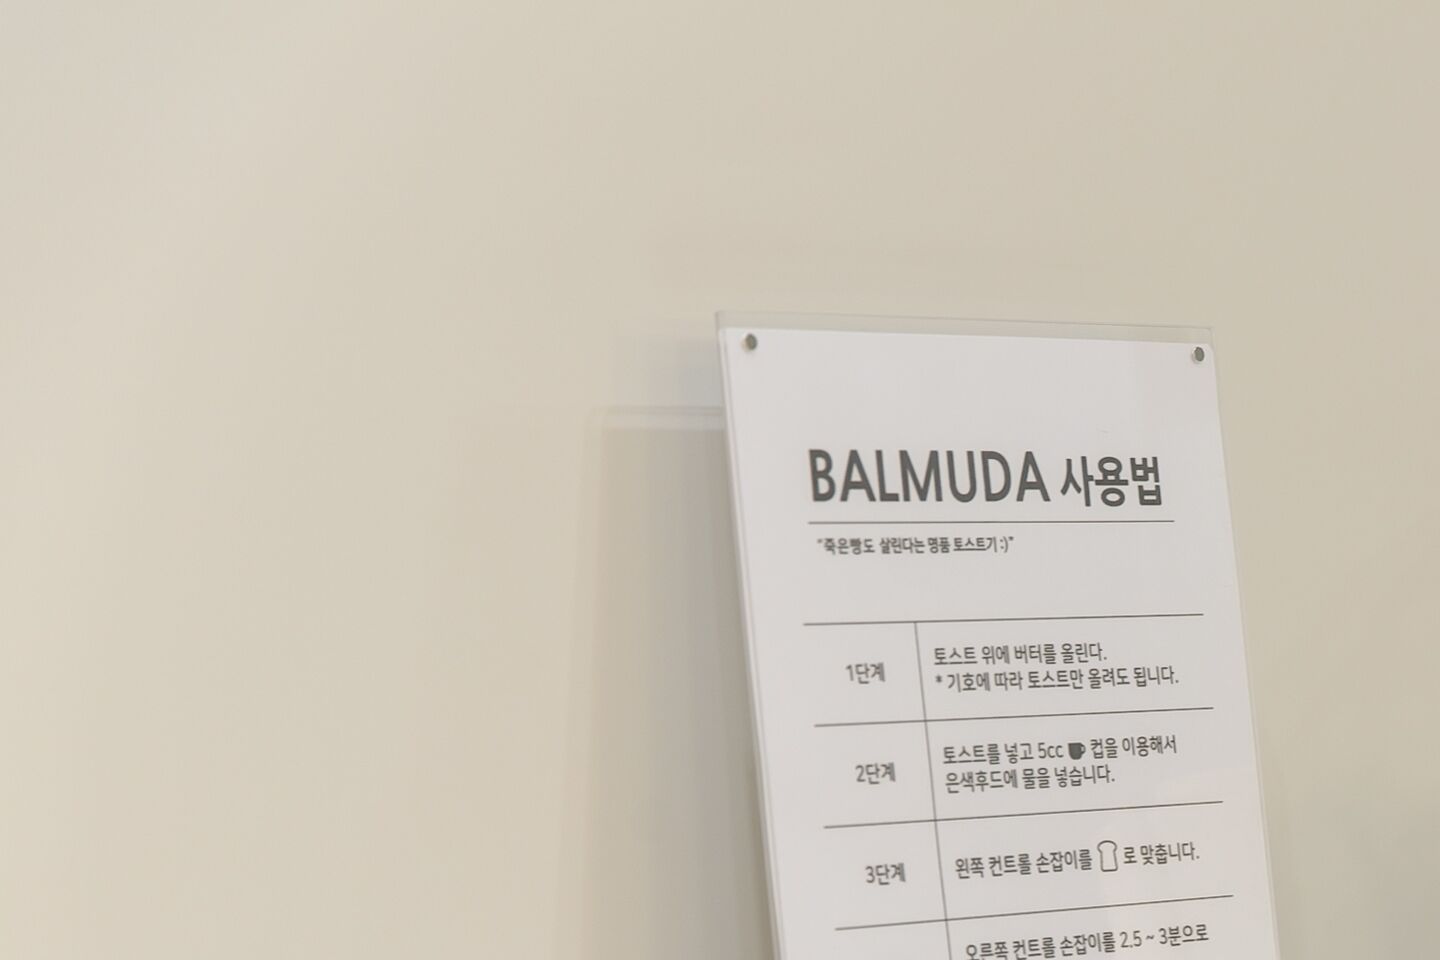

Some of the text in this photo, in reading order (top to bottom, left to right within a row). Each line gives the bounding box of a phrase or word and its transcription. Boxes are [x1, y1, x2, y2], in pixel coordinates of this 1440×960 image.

[808, 449, 1162, 508] BALMUDA 사용법
[879, 537, 926, 555] 살린다는
[927, 536, 951, 554] 명품
[953, 536, 998, 553] 토스트기
[934, 642, 1107, 666] 토스트 위에 버터를 올린다.
[845, 662, 886, 685] 1단계
[947, 672, 991, 693] 기호에
[993, 671, 1024, 691] 따라
[1027, 668, 1084, 690] 토스트만
[1087, 667, 1131, 690] 올려도
[1133, 665, 1179, 688] 됩니다.
[943, 734, 1177, 766] 토스트를 넣고 5cc 컵을 이용해서
[855, 762, 896, 785] 2단계
[945, 764, 1115, 794] 은색후드에 물을 넣습니다.
[865, 862, 906, 886] 3단계
[955, 841, 1200, 880] 왼쪽 컨트롤 손잡이를 로 맞춥니다.
[1012, 936, 1057, 960] 컨트롤
[1059, 931, 1116, 957] 손잡이를
[1119, 930, 1142, 949] 2.5
[1158, 923, 1209, 947] 3분으로
